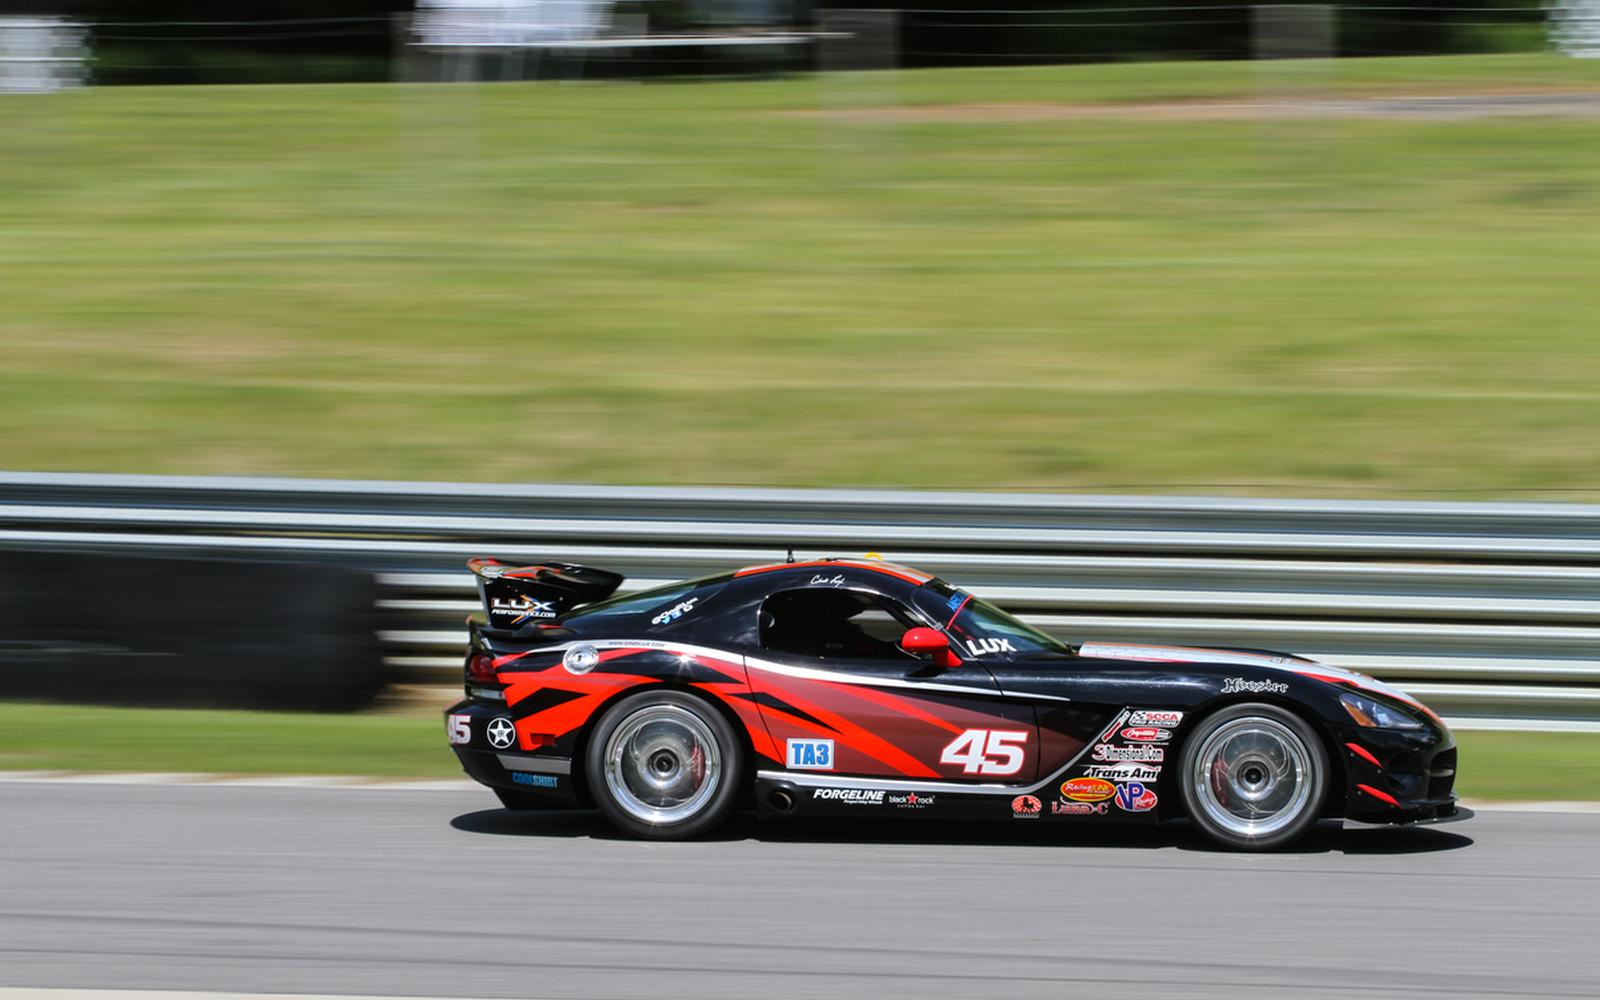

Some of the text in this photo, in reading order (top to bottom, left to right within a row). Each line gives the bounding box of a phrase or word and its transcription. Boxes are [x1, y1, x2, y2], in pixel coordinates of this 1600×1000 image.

[491, 597, 556, 611] LUX
[966, 638, 1017, 656] LUX
[1220, 677, 1289, 694] Hoosier
[1145, 712, 1178, 721] SCCA
[791, 743, 830, 766] TA3
[940, 728, 1029, 776] 45
[1089, 766, 1157, 779] Trans Am
[812, 788, 886, 801] FORGELINE
[889, 795, 936, 805] black rock
[1116, 781, 1146, 812] VP
